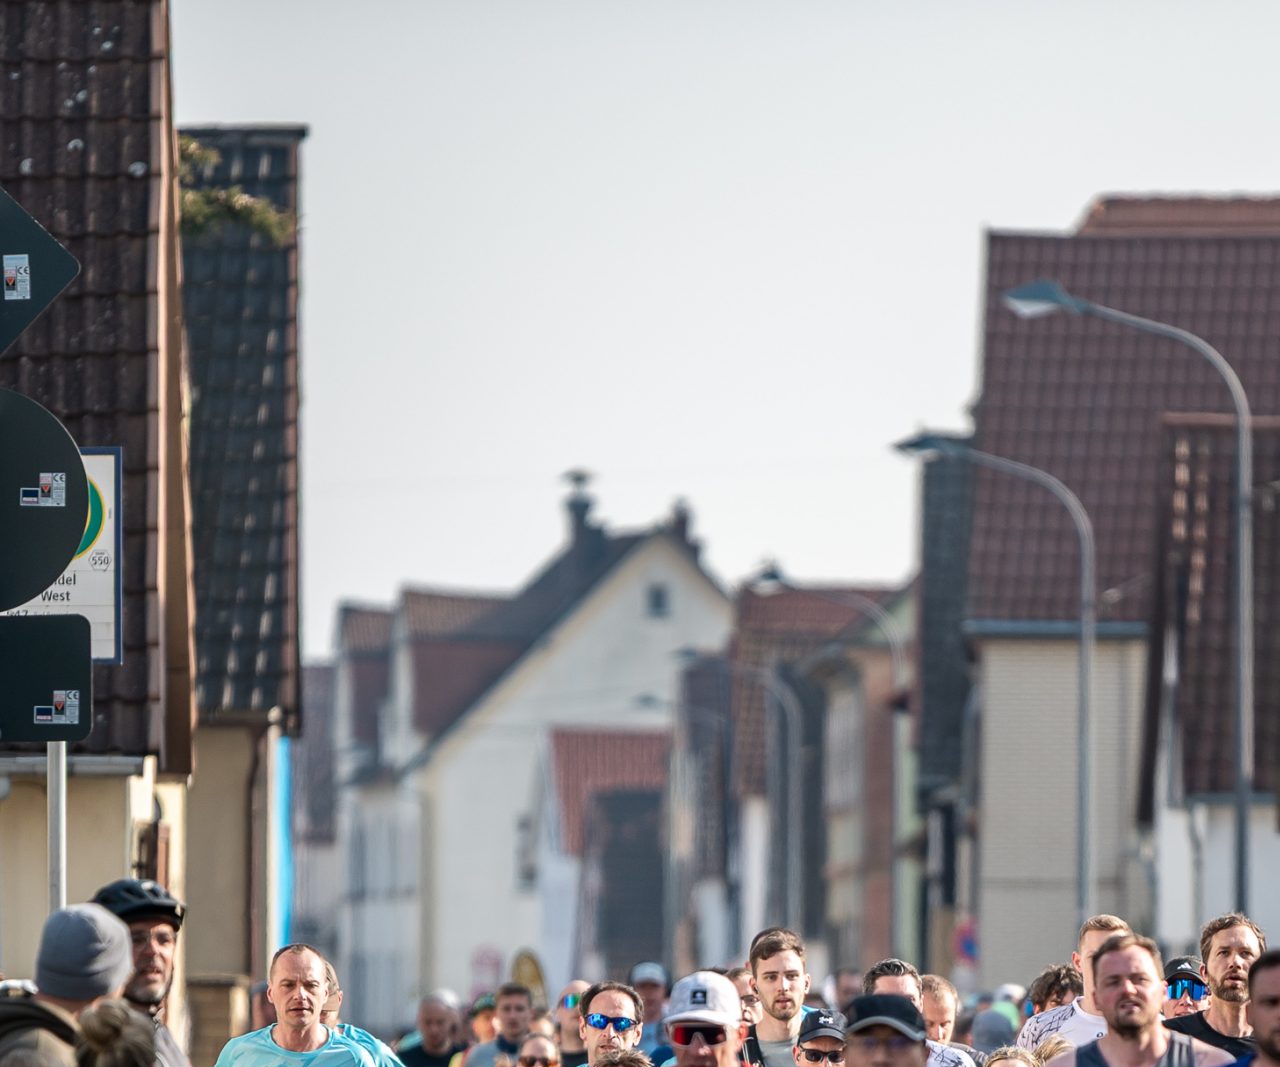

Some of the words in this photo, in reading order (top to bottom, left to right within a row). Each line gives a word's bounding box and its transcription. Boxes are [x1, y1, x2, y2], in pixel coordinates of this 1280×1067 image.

[91, 556, 110, 566] 550
[54, 573, 77, 585] del
[41, 590, 71, 601] West
